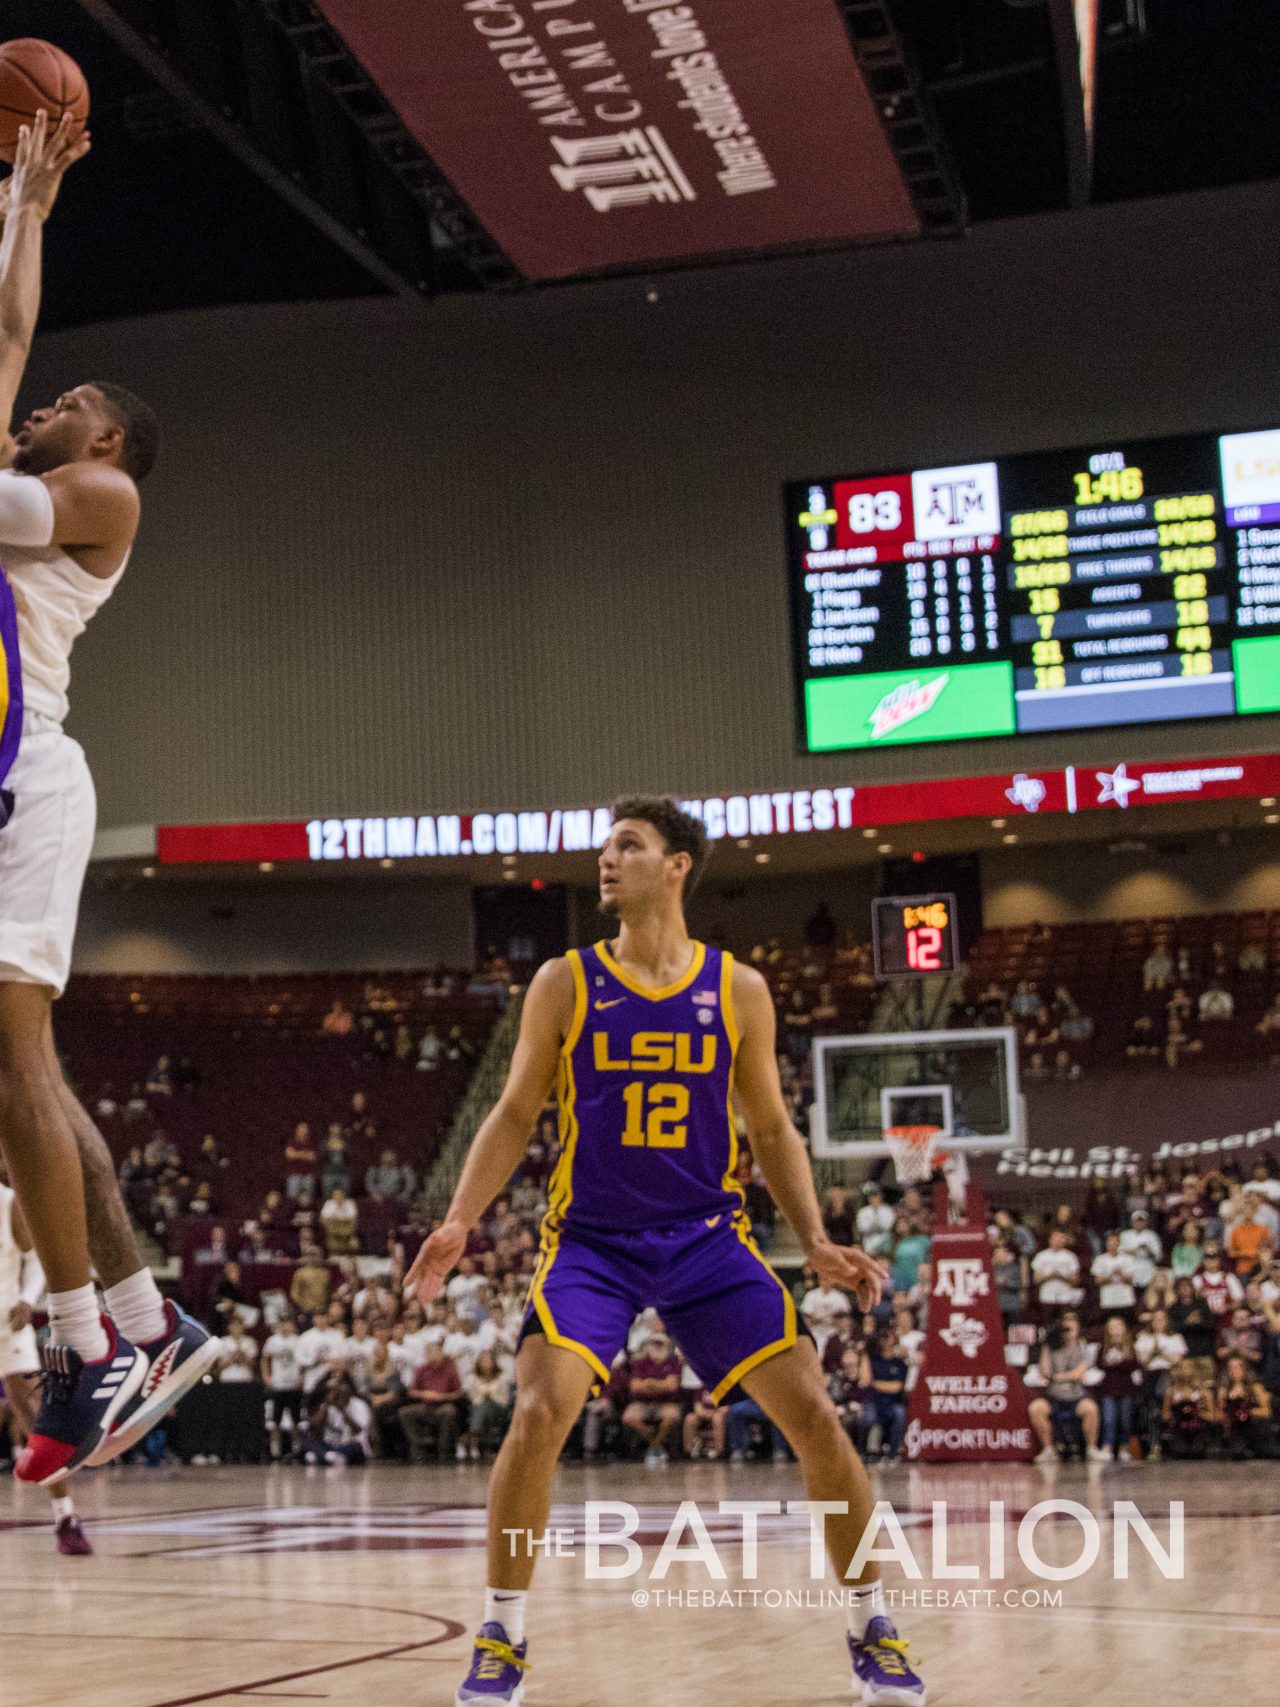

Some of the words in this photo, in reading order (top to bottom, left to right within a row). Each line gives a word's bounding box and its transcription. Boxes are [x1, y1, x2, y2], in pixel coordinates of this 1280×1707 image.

[646, 5, 709, 59] love
[664, 50, 751, 139] students
[713, 134, 778, 197] Where
[1074, 467, 1144, 505] 1:46
[848, 490, 902, 534] 83
[1036, 614, 1055, 639] 7
[906, 926, 942, 972] 12
[592, 1031, 718, 1074] LSU
[620, 1081, 690, 1149] 12
[996, 1160, 1139, 1178] Health
[1001, 1147, 1075, 1164] CHI
[1087, 1145, 1142, 1163] St.
[925, 1375, 1008, 1394] WELLS
[929, 1394, 1008, 1415] FARGO
